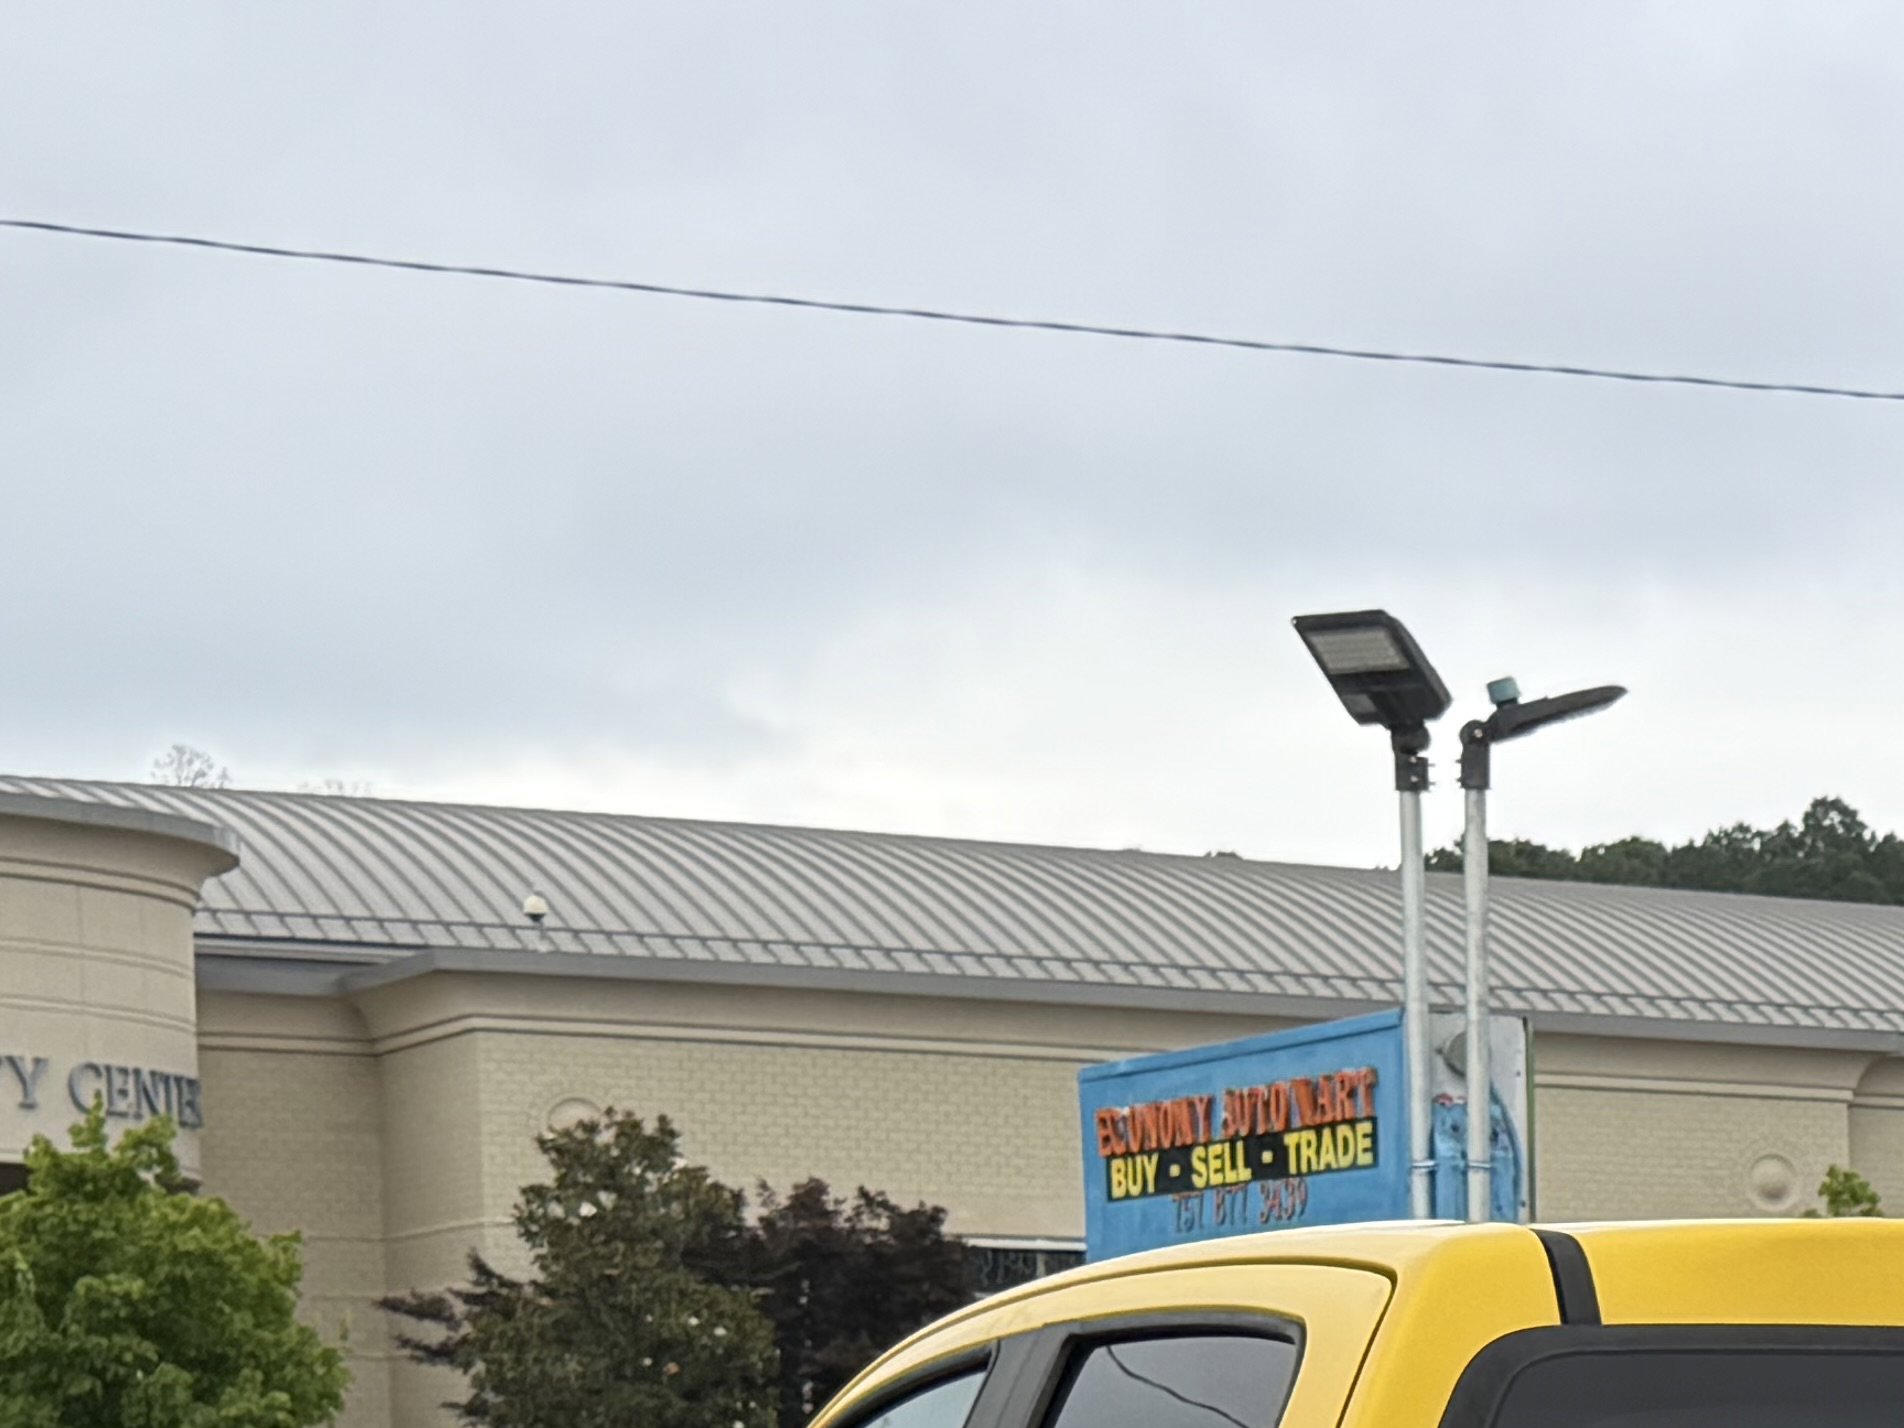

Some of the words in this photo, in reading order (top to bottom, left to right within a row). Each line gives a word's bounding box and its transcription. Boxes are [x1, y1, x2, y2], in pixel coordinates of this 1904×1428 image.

[1094, 1095, 1213, 1156] ECONOMY
[1110, 1155, 1158, 1199] BUY
[1191, 1139, 1252, 1188] SELL
[1283, 1121, 1374, 1176] TRADE
